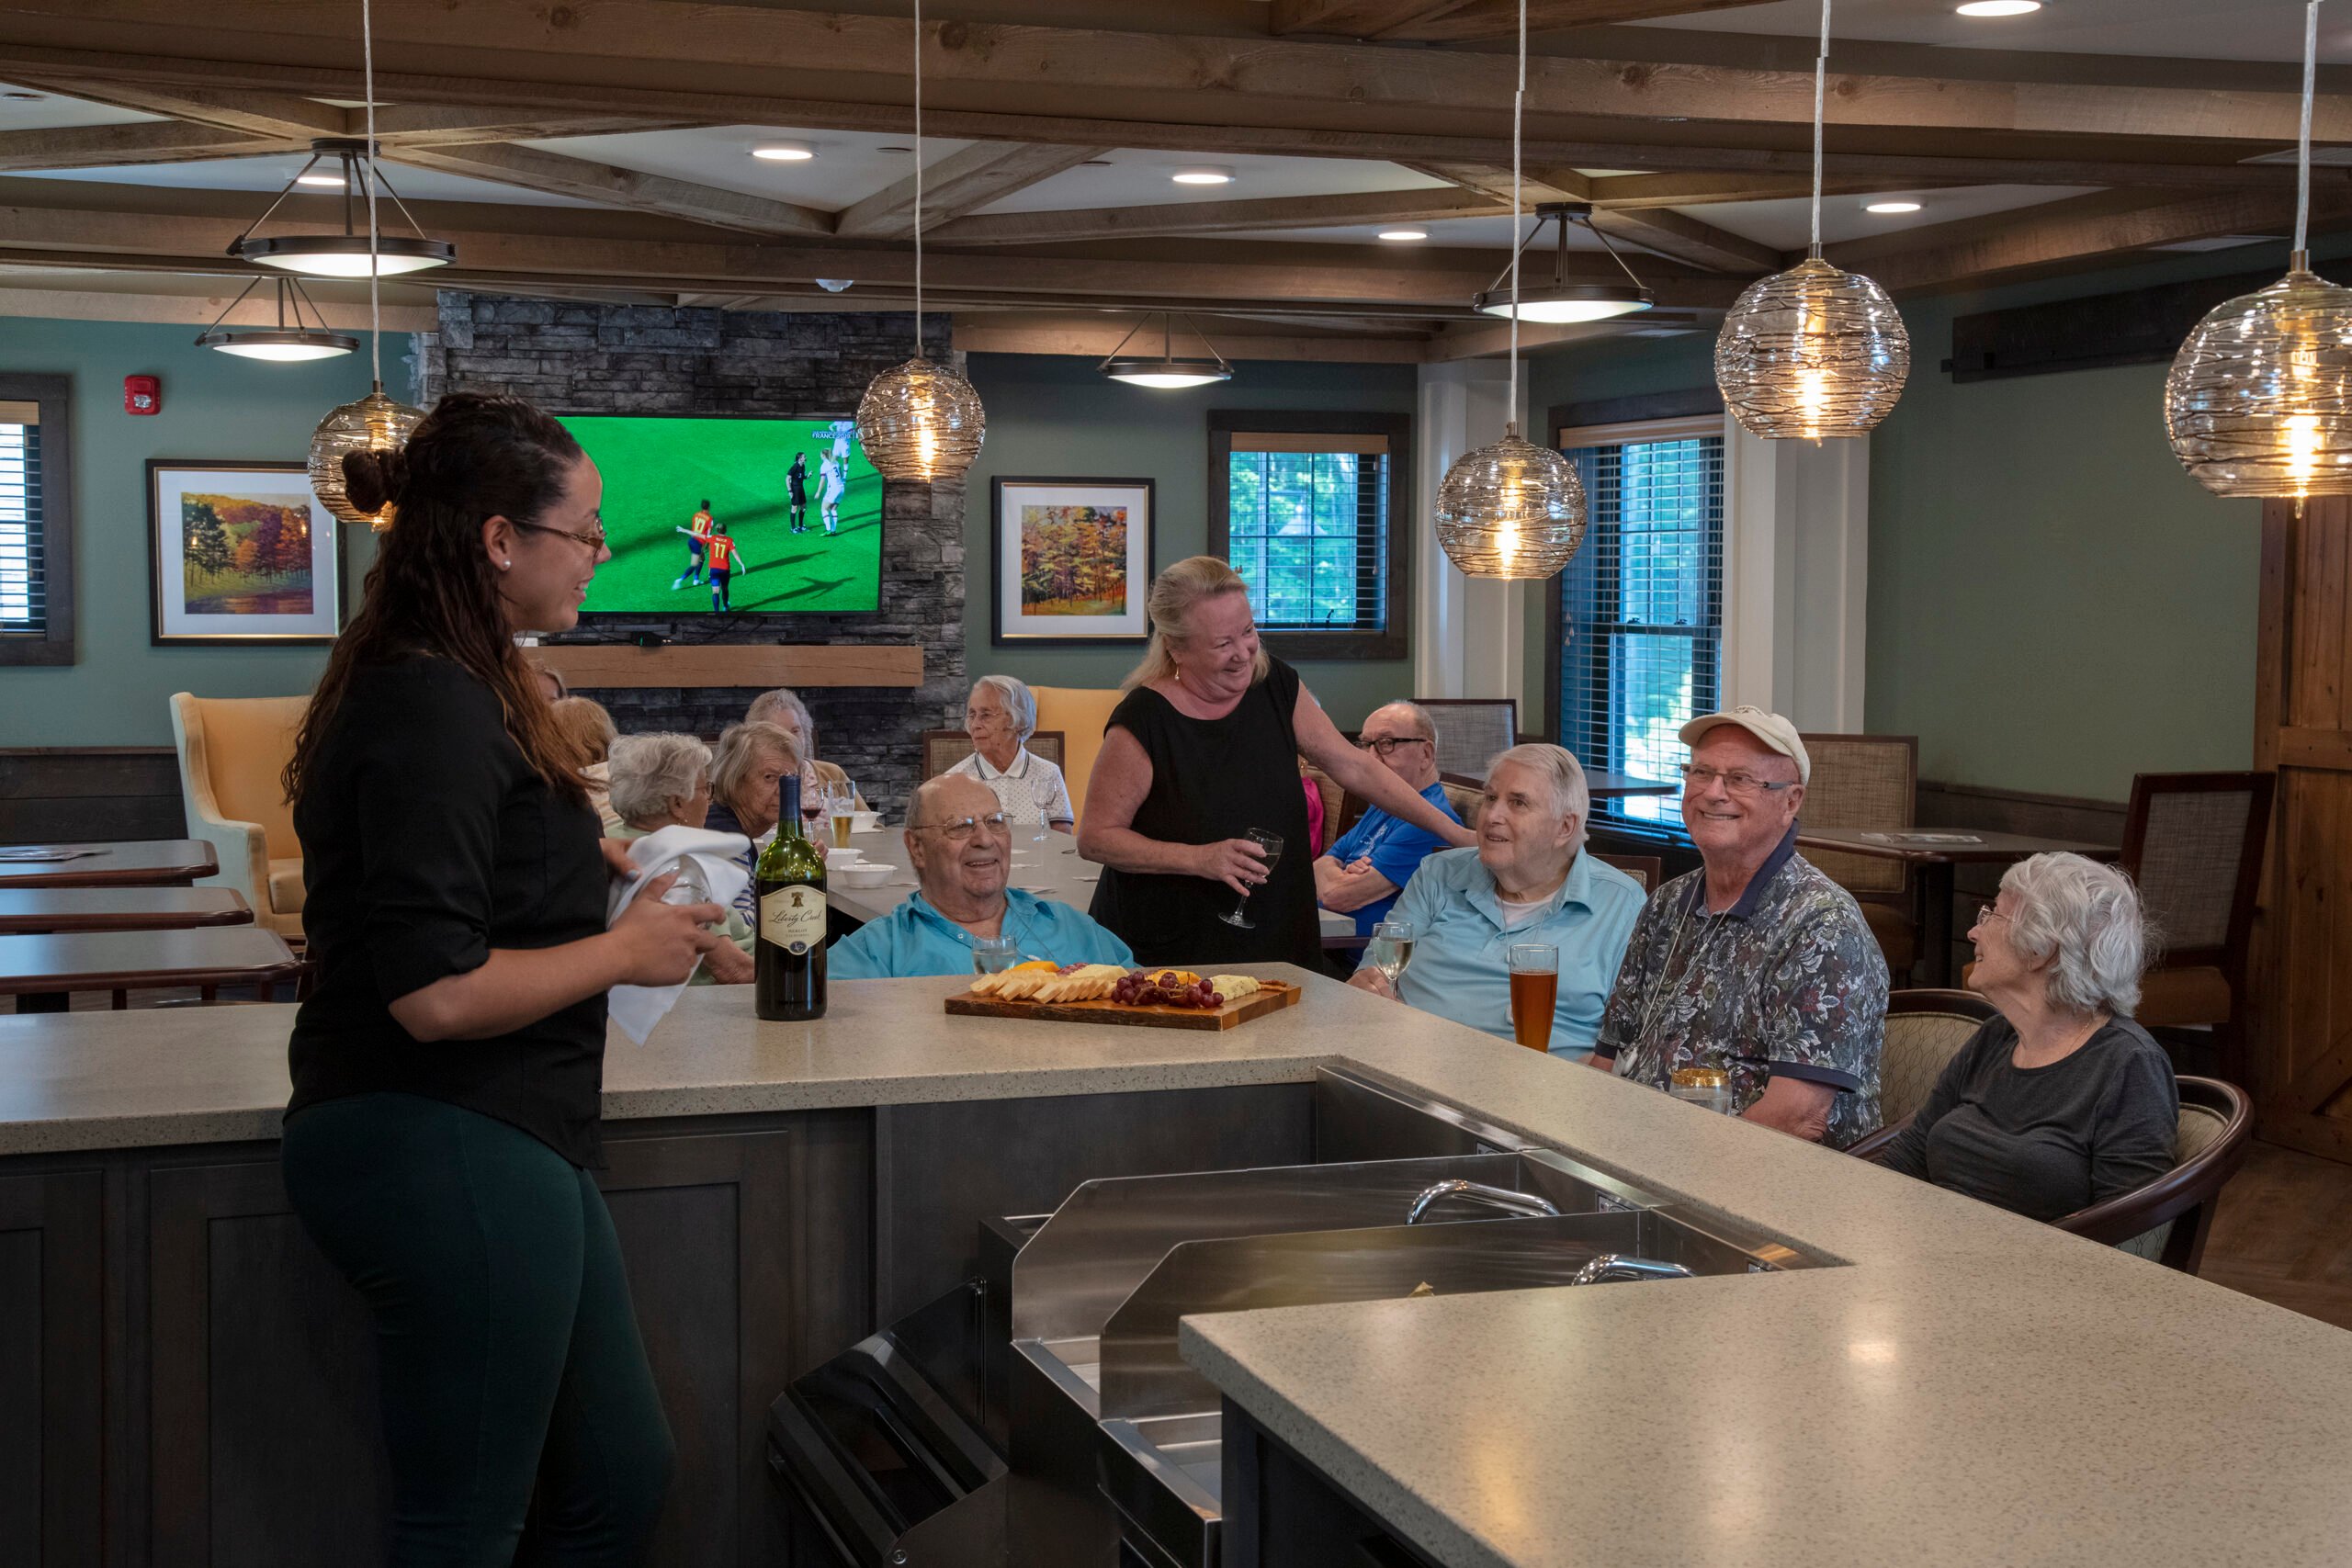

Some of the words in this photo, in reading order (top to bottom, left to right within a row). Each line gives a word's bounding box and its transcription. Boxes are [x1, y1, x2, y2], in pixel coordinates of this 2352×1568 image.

[832, 466, 840, 478] 3
[694, 516, 707, 534] 10
[714, 542, 726, 559] 11
[769, 909, 798, 928] Liberty
[800, 909, 822, 922] Creek
